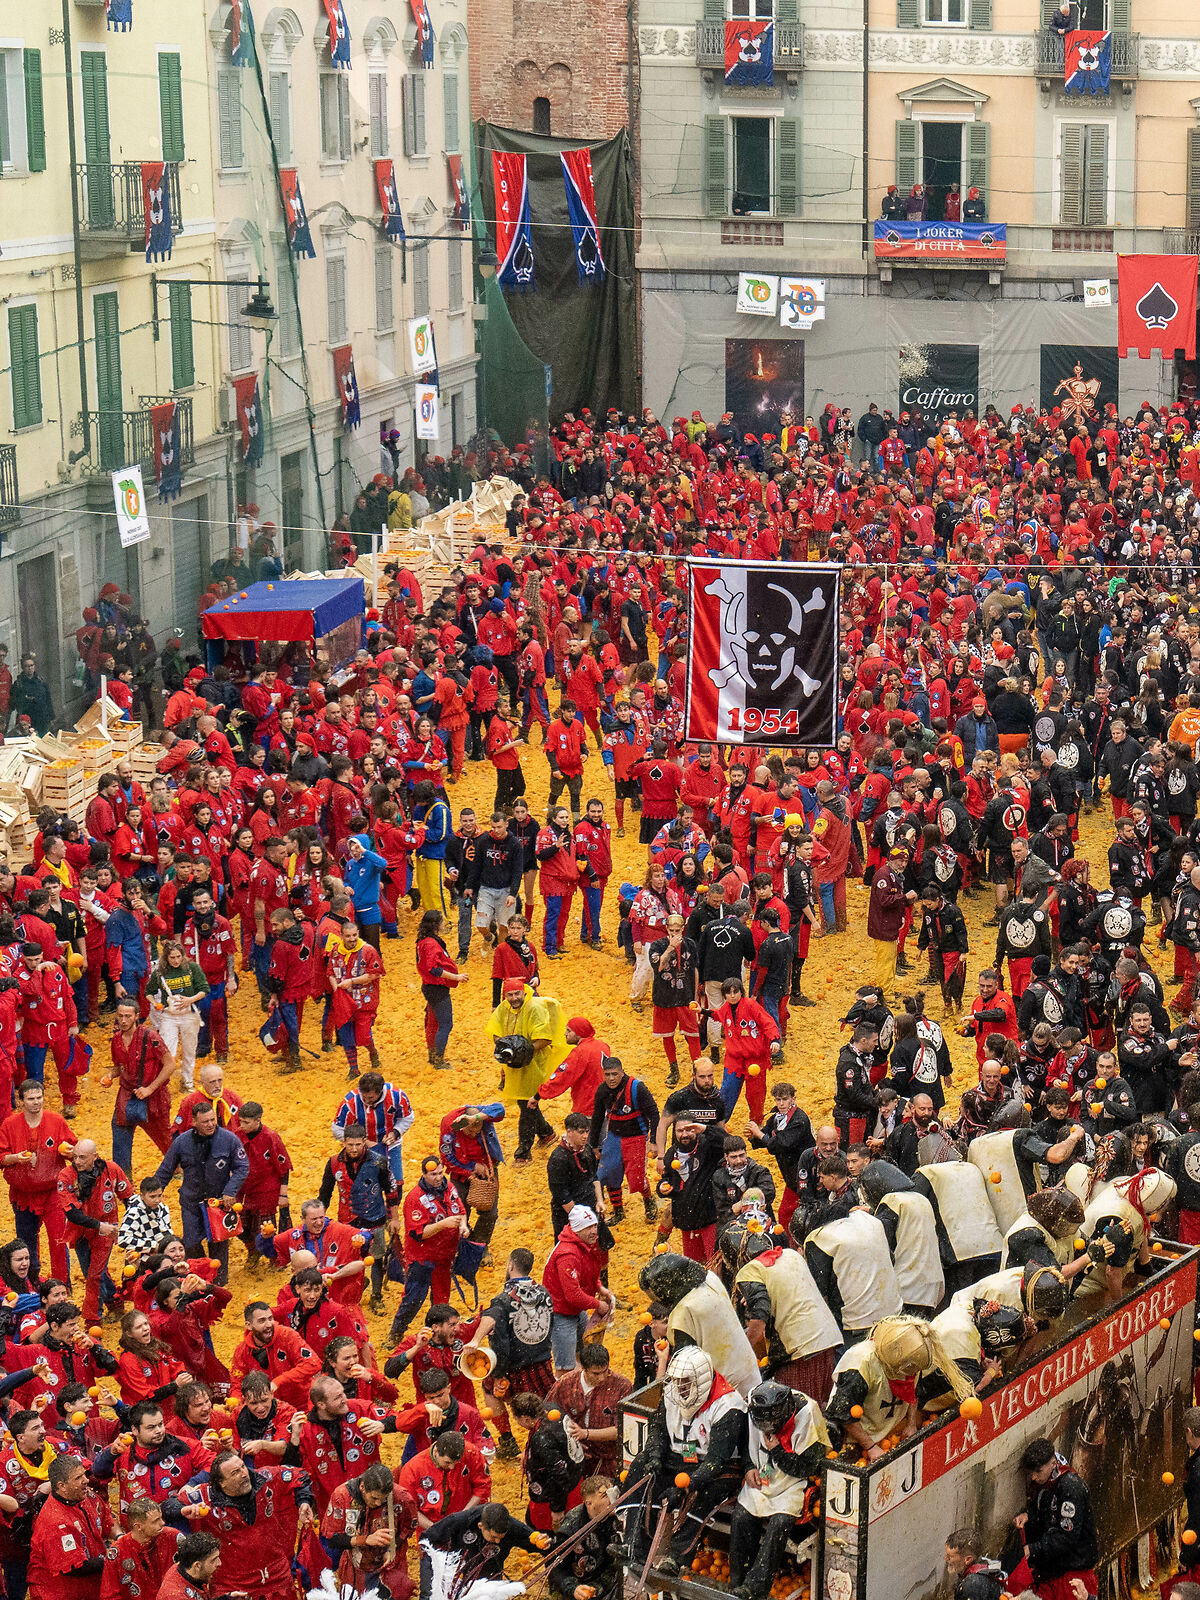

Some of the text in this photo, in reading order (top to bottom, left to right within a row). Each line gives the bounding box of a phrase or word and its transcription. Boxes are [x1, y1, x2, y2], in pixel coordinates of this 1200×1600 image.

[915, 239, 965, 251] DI CITTÀ
[916, 228, 964, 238] I JOKER
[902, 387, 975, 410] Caffaro
[727, 707, 800, 735] 1954
[944, 1279, 1177, 1465] LA VECCHIA TORRE
[622, 1420, 648, 1457] J
[901, 1449, 919, 1494] J
[828, 1476, 855, 1518] J
